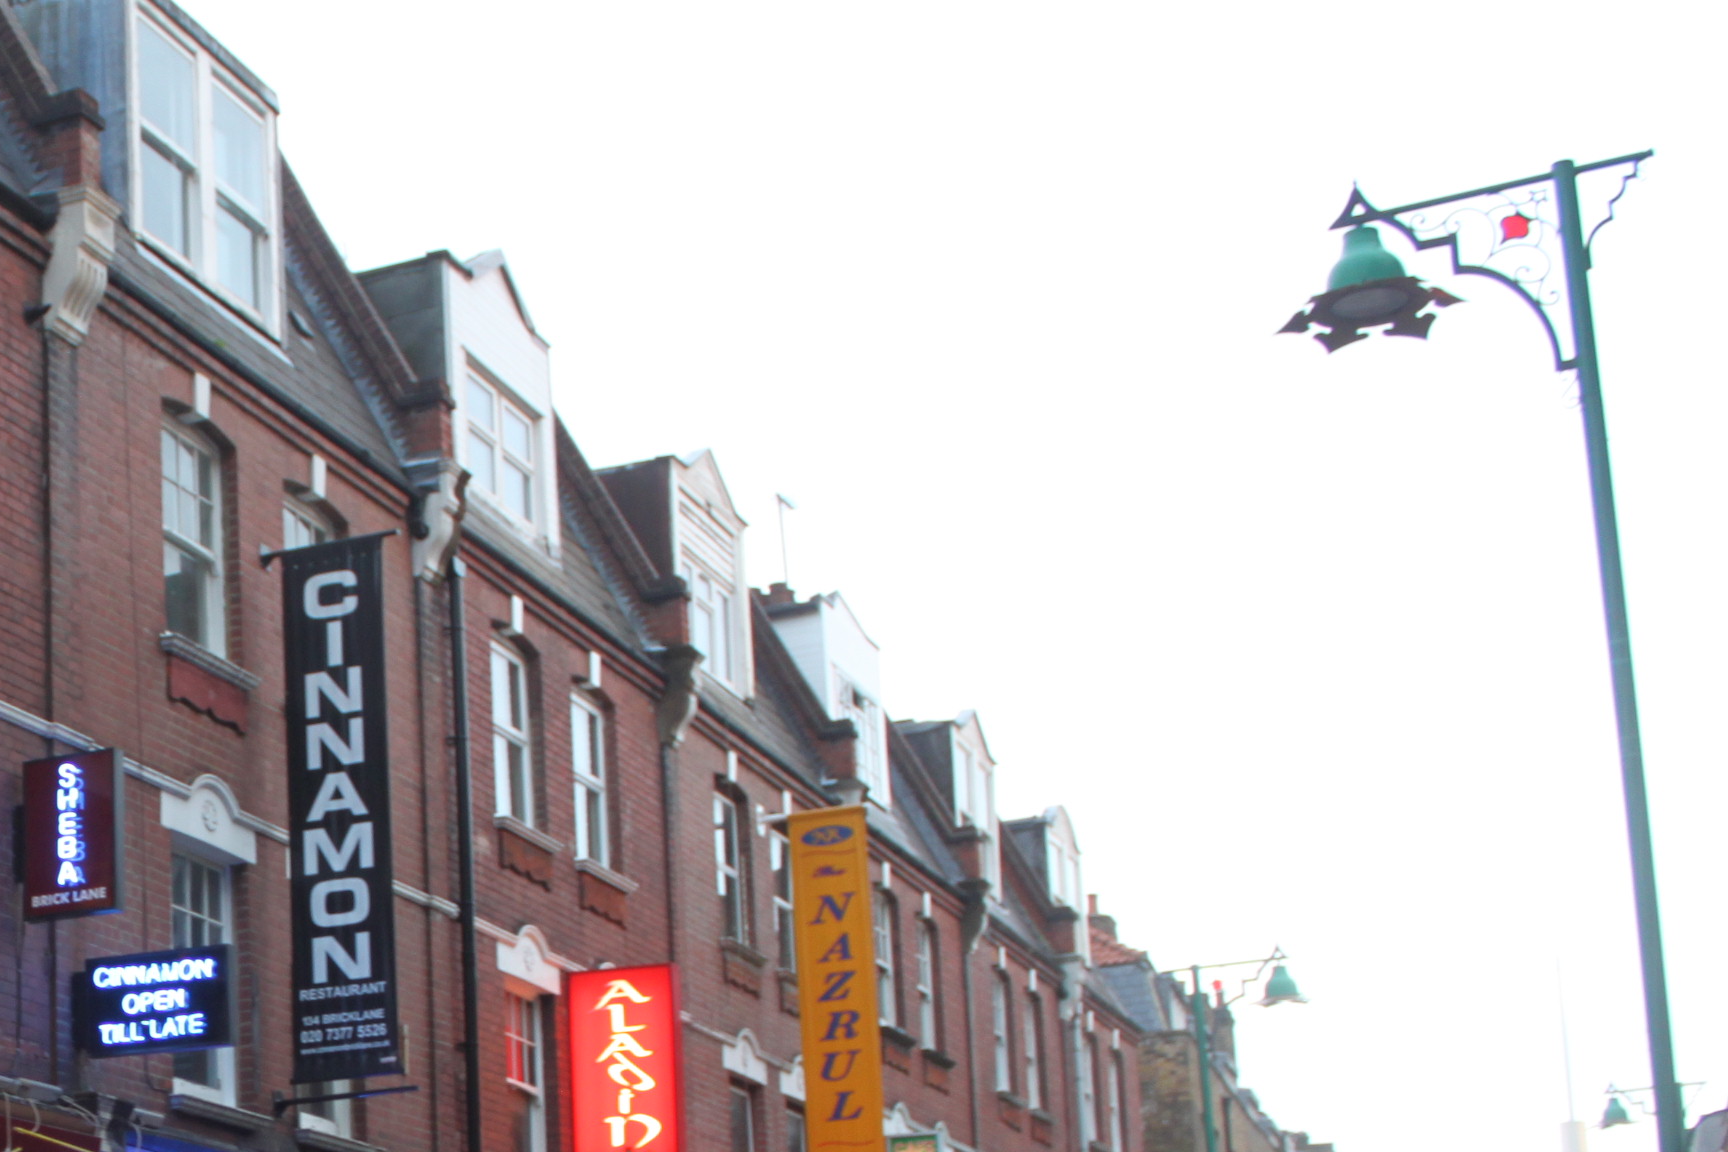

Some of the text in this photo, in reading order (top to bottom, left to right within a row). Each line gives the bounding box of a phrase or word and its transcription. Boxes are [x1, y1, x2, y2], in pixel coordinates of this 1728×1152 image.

[302, 568, 375, 984] CINNAMON
[57, 761, 80, 886] SHEBA
[31, 886, 108, 909] BRICK LANE
[92, 957, 216, 990] CINNAMON
[121, 987, 188, 1015] OPEN
[298, 980, 387, 1002] RESTAURANT
[809, 891, 864, 1122] NAZRUL
[98, 1020, 145, 1046] TILL
